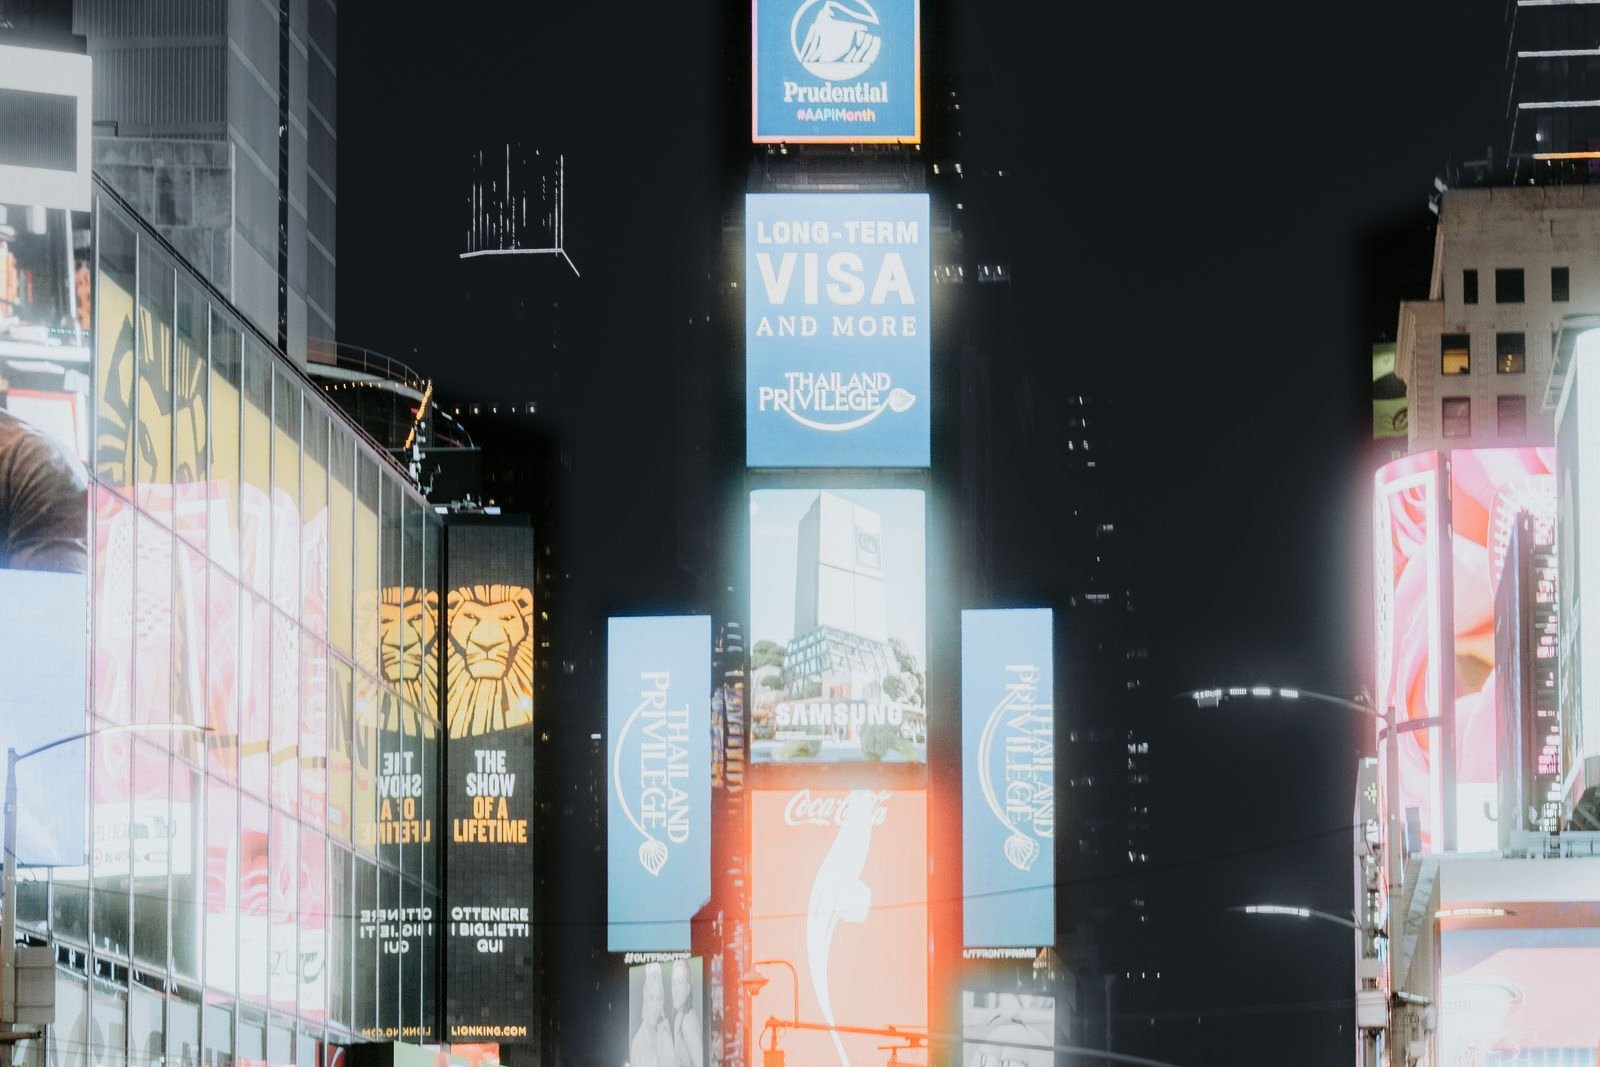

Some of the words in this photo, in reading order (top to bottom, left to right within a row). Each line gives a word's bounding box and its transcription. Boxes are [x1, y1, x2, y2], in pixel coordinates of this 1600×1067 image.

[783, 81, 889, 103] Prudential
[797, 108, 877, 122] #AAPIMonth
[757, 221, 919, 244] LONG-TERM
[755, 252, 916, 305] VISA
[755, 316, 818, 337] AND
[832, 316, 917, 337] MORE
[784, 372, 891, 392] THAILAND
[759, 386, 882, 412] PRIVILEGE
[775, 702, 903, 726] SAMSUNG
[641, 671, 669, 830] PRIVILEGE
[1005, 664, 1039, 825] PRIVILEGE
[474, 750, 507, 774] THE
[667, 703, 689, 844] THAILAND
[466, 773, 516, 797] SHOW
[473, 796, 494, 819] OF
[496, 797, 509, 819] A
[453, 818, 528, 843] LIFETIME
[451, 907, 529, 921] OTTENERE
[451, 923, 456, 936] I
[459, 923, 529, 937] BIGLIETTI
[476, 939, 503, 953] QUI
[451, 1026, 527, 1037] LIONKING.COM
